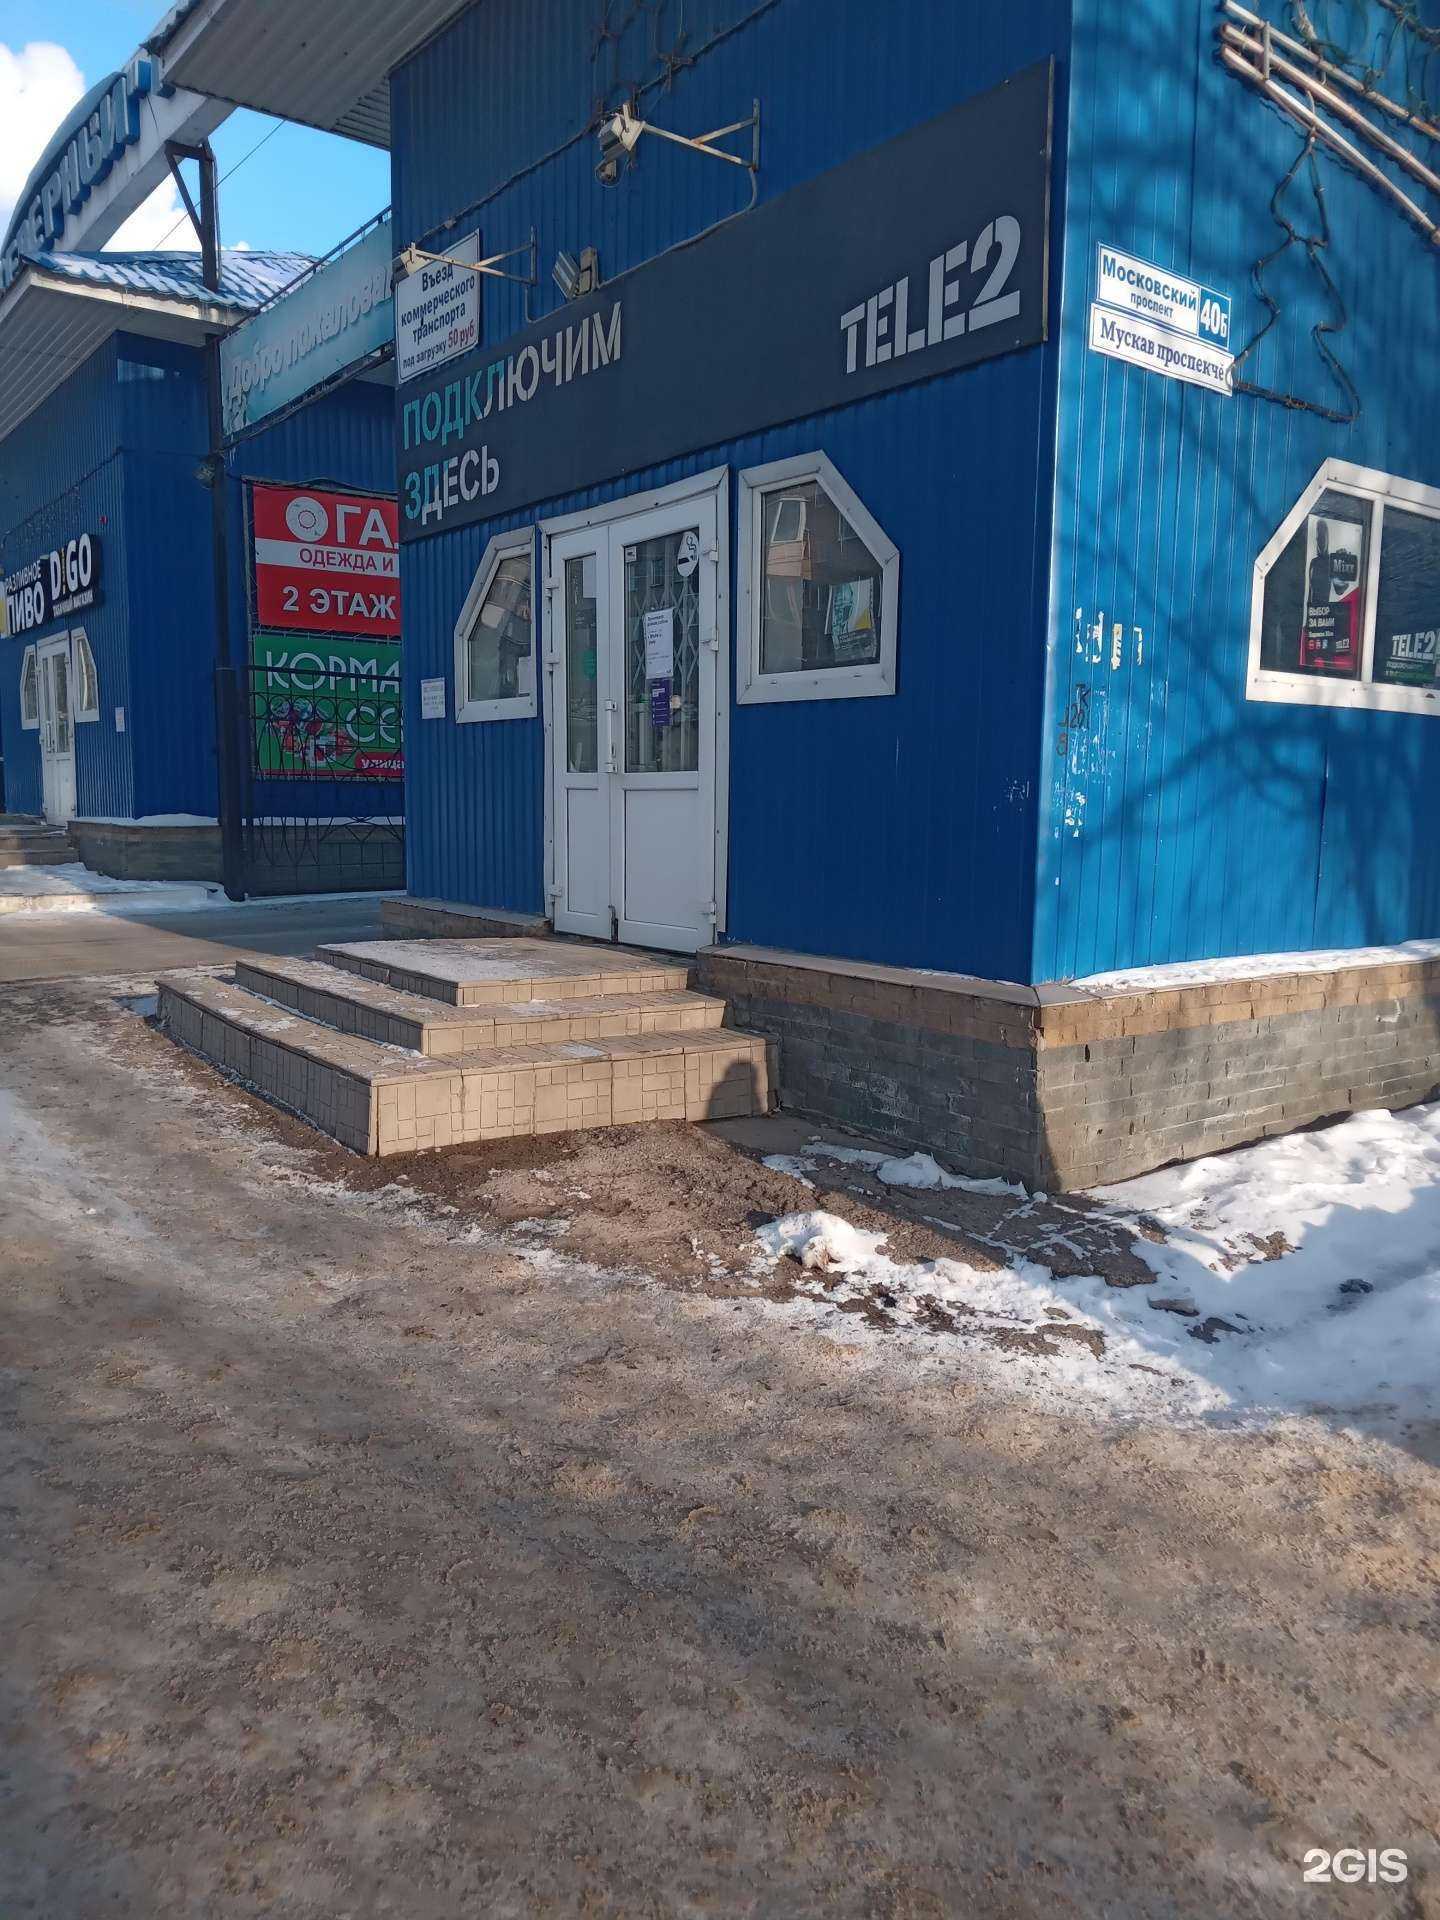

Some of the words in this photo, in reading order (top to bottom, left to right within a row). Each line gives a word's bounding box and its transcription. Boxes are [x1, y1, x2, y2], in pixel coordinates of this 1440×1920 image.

[421, 264, 454, 292] Въезд
[840, 215, 1021, 375] TELE2
[1101, 254, 1197, 312] Московский
[400, 275, 476, 328] коммерческого
[1130, 291, 1174, 319] проспект
[402, 355, 415, 370] под
[416, 338, 447, 364] загрузку
[447, 328, 459, 350] 50
[459, 319, 475, 348] руб
[412, 302, 467, 346] транспорта
[1100, 317, 1156, 357] Мускав
[403, 300, 622, 450] ПОДКЛЮЧИМ
[405, 445, 500, 526] ЗДЕСЬ
[300, 548, 378, 572] ОДЕЖДА
[382, 557, 394, 572] И
[7, 580, 45, 635] ПИВО
[282, 585, 300, 612] 2
[309, 588, 397, 620] ЭТАЖ
[1391, 630, 1436, 660] TELE2
[266, 650, 400, 694] КОРМА
[346, 705, 404, 745] СЕ
